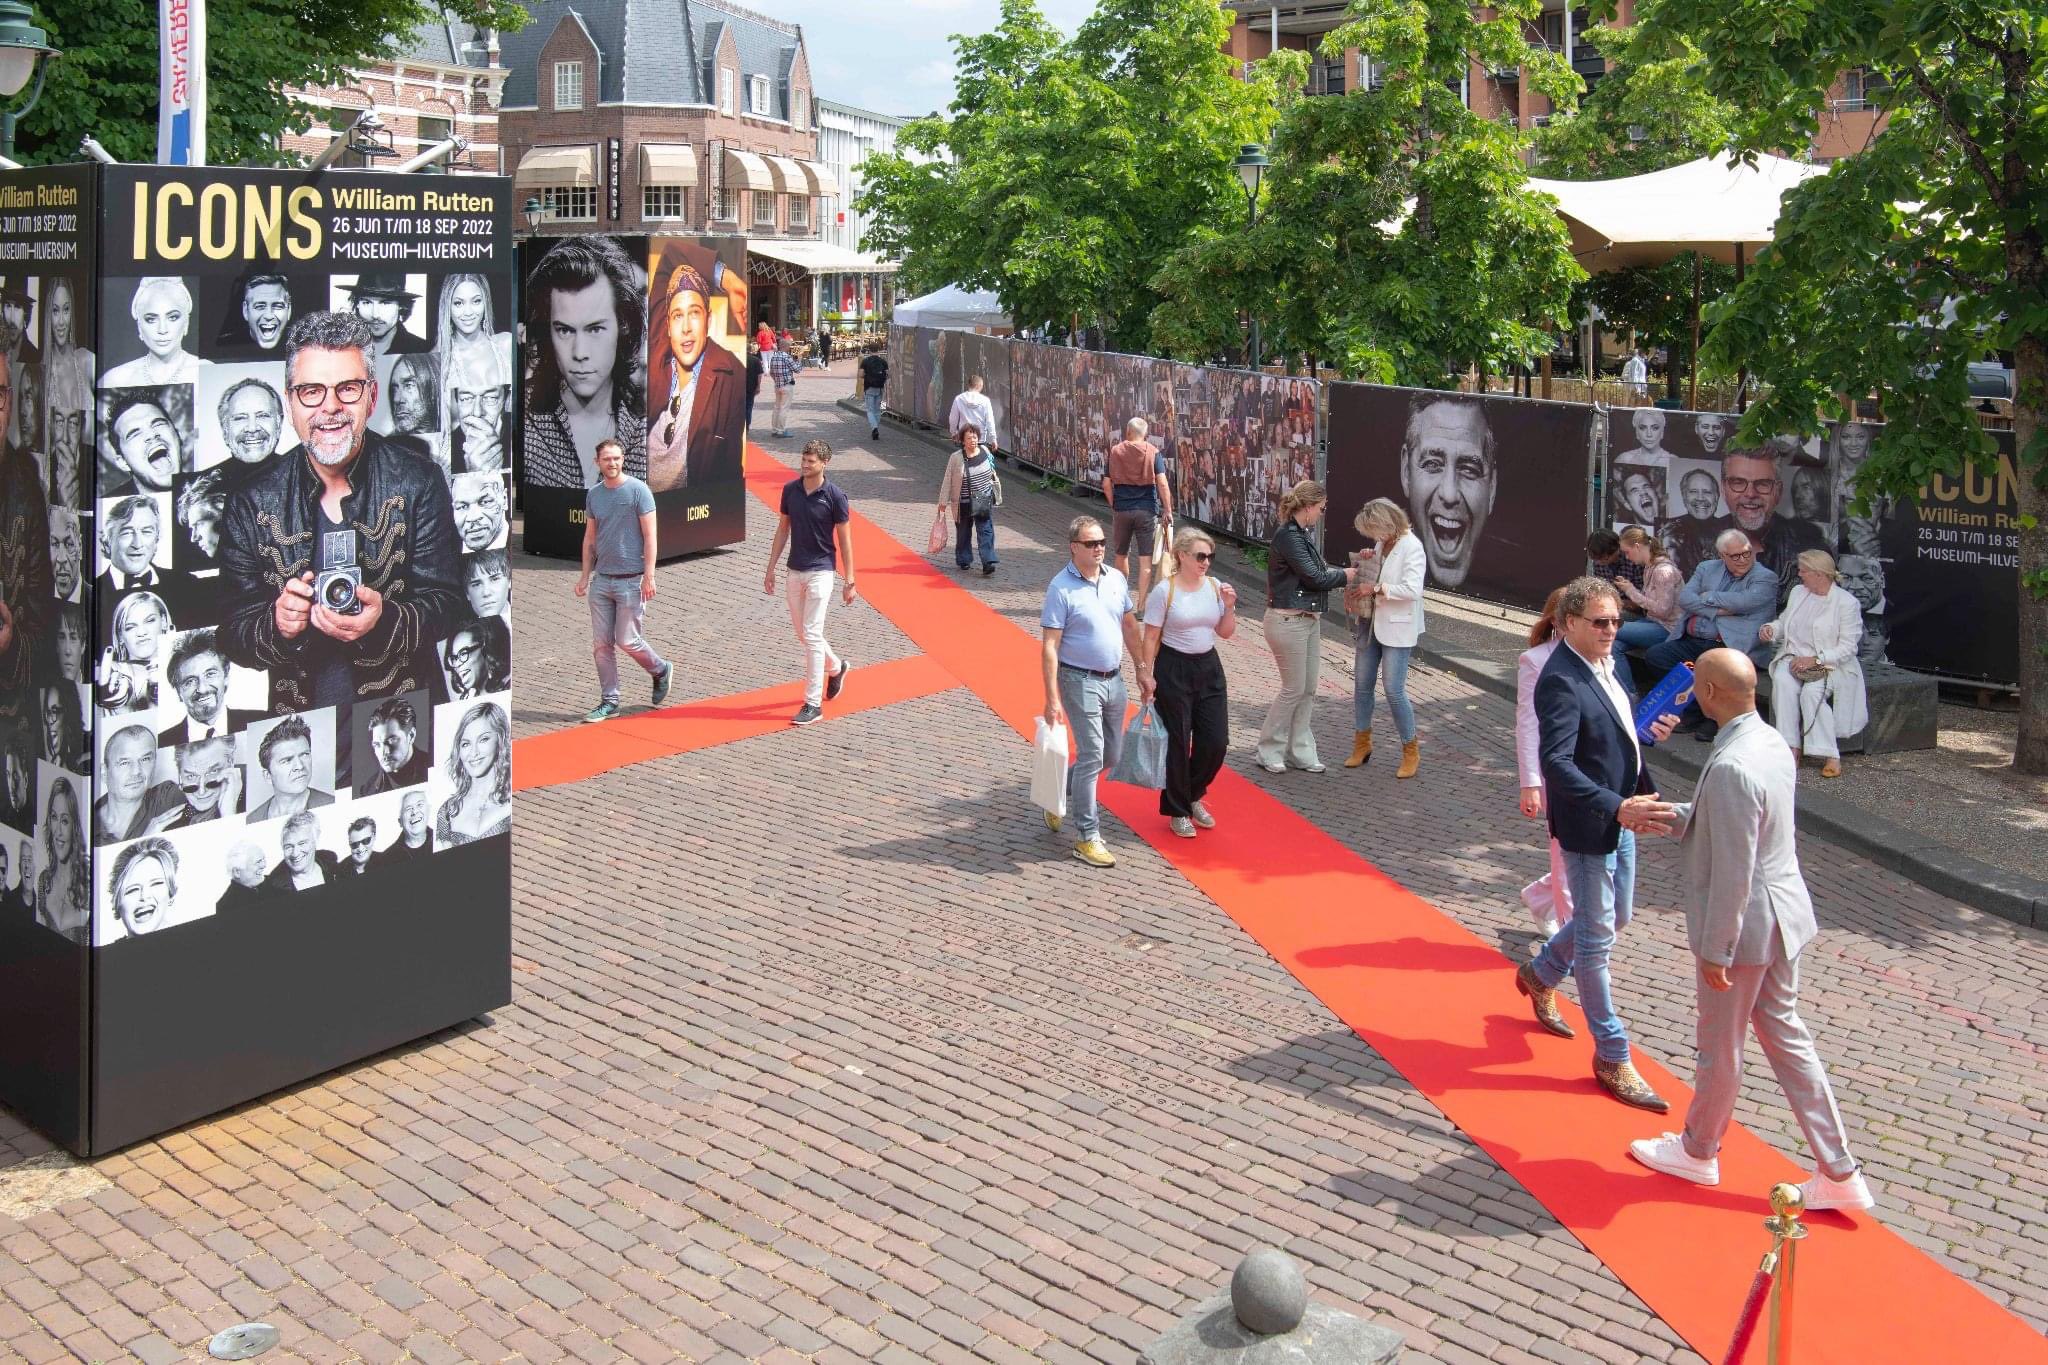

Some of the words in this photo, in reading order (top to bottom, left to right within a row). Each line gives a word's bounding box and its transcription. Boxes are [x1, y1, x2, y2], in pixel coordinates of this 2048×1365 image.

[37, 184, 77, 207] Rutten
[331, 188, 416, 211] William
[423, 191, 494, 212] Rutten
[33, 215, 42, 232] 18
[43, 214, 56, 232] SEP
[58, 214, 77, 232] 2022
[133, 181, 323, 260] ICONS
[332, 217, 350, 233] 26
[354, 217, 381, 234] JUN
[385, 218, 411, 234] T/M
[416, 218, 431, 234] 18
[435, 218, 459, 235] SEP
[462, 219, 493, 235] 2022
[0, 241, 77, 260] USEUMHILVERSUM
[569, 508, 587, 524] ICO
[687, 504, 710, 522] ICONS
[1918, 506, 1988, 527] William
[1918, 527, 1933, 540] 26
[1935, 529, 1958, 542] JUN
[1961, 531, 1984, 545] T/M
[1988, 534, 2002, 546] 18
[2005, 536, 2019, 548] SE
